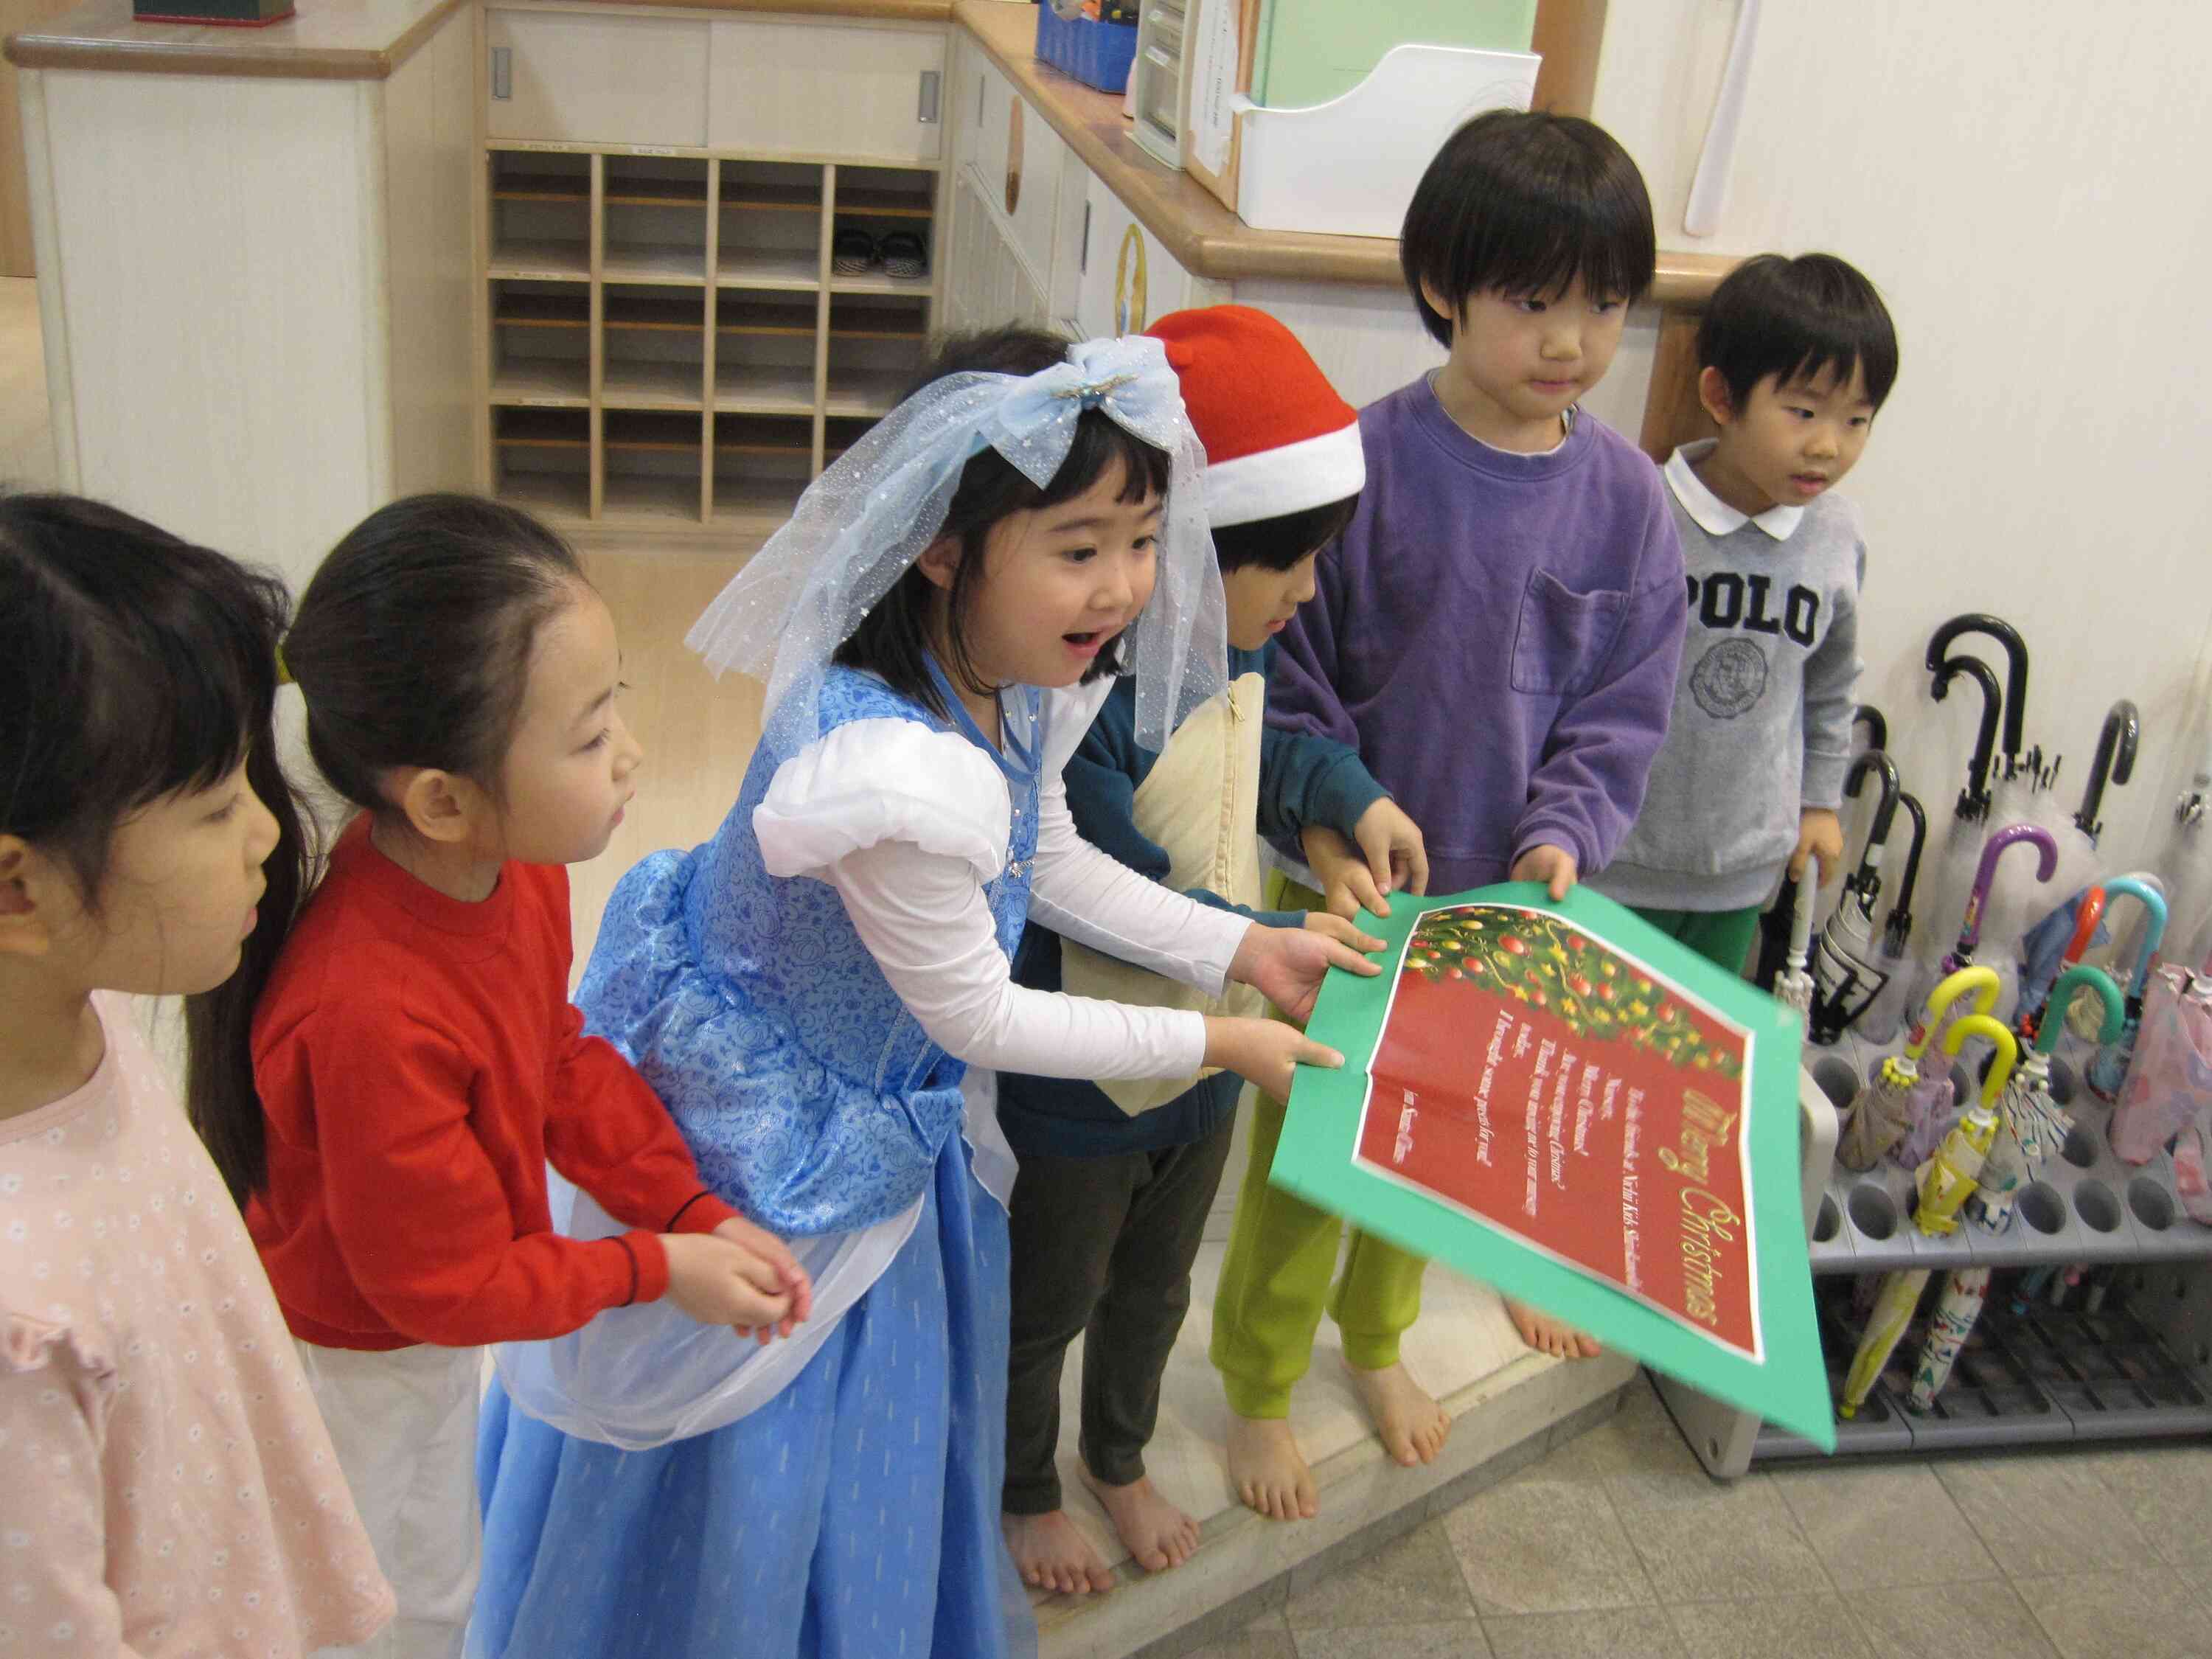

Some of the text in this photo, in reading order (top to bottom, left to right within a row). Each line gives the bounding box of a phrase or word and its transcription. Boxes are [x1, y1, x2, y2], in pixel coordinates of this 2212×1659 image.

[1623, 1203, 1638, 1227] Kids
[1658, 1088, 1740, 1326] Merry Christmas
